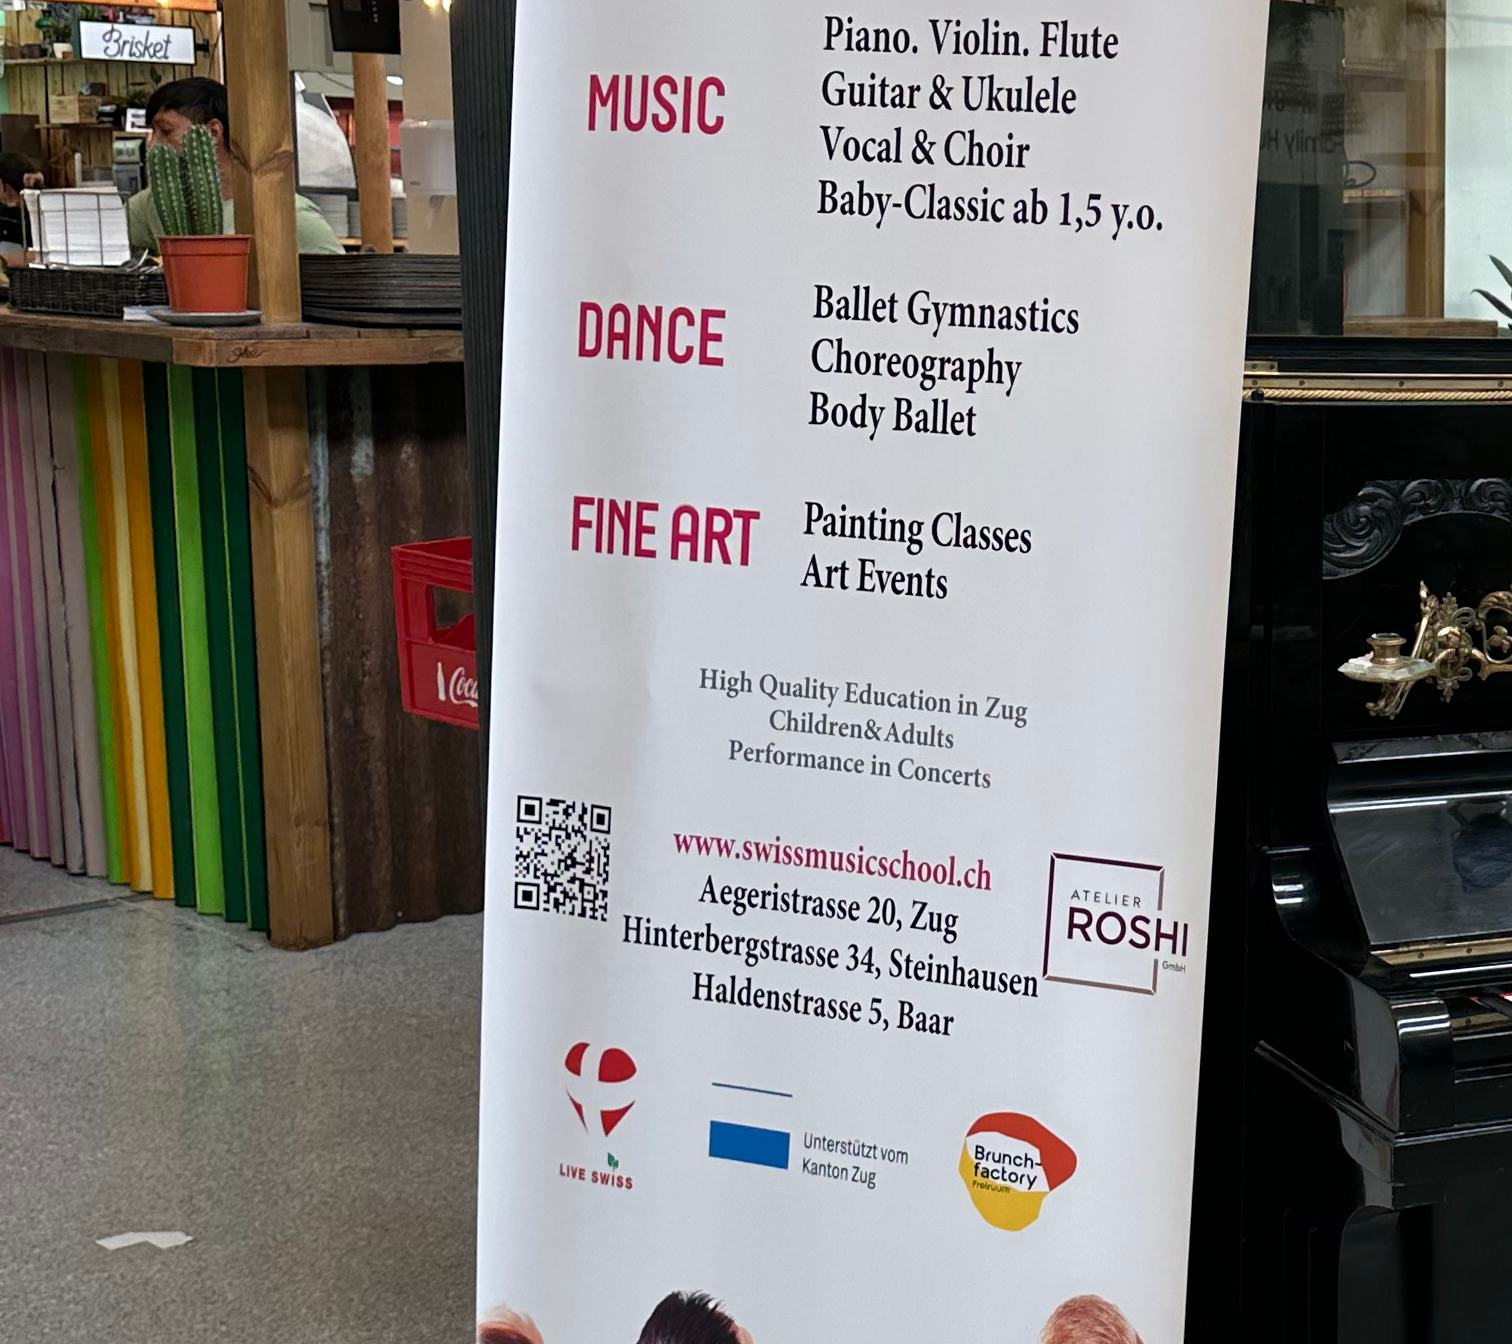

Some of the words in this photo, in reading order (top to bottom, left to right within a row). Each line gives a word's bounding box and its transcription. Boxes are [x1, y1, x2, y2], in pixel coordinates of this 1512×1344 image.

[102, 24, 171, 60] Brisket
[822, 15, 919, 55] Piano.
[927, 17, 1030, 58] Violin.
[1038, 19, 1119, 60] Flute
[587, 73, 726, 136] MUSIC
[821, 70, 922, 110] Guitar
[928, 73, 955, 112] &
[961, 73, 1077, 115] Ukulele
[819, 124, 903, 164] Vocal
[910, 128, 938, 166] &
[943, 128, 1031, 169] Choir
[816, 179, 1006, 230] Baby-Classic
[1012, 186, 1049, 226] ab
[1058, 191, 1102, 234] 1,5
[1110, 203, 1163, 242] y.o.
[577, 300, 727, 368] DANCE
[812, 284, 899, 324] Ballet
[906, 289, 1080, 339] Gymnastics
[810, 337, 1023, 398] Choreography
[807, 390, 887, 442] Body
[891, 396, 978, 437] Ballet
[571, 495, 660, 559] FINE
[669, 503, 761, 567] ART
[802, 500, 926, 557] Painting
[931, 511, 1032, 554] Classes
[799, 553, 850, 591] Art
[855, 557, 948, 600] Events
[698, 667, 753, 699] High
[759, 673, 840, 709] Quality
[843, 681, 952, 714] Education
[956, 693, 979, 717] in
[984, 695, 1028, 729] Zug
[728, 739, 865, 775] Performance
[870, 753, 892, 778] in
[897, 757, 991, 789] Concerts
[672, 833, 992, 892] www.swissmusicschool.ch
[697, 874, 861, 922] Aegeristrasse
[866, 895, 903, 933] 20,
[909, 899, 960, 945] Zug
[1070, 889, 1141, 908] ATELIER
[622, 913, 840, 970] Hinterbergstrasse
[845, 943, 882, 981] 34,
[888, 947, 1039, 998] Steinhausen
[1067, 906, 1188, 957] ROSHI
[691, 971, 863, 1023] Haldenstrasse
[867, 996, 890, 1032] 5,
[896, 999, 955, 1037] Baar
[802, 1157, 849, 1181] Kanton
[851, 1165, 877, 1190] Zug
[803, 1131, 879, 1161] Unterstützt
[880, 1147, 909, 1166] vom
[974, 1144, 1043, 1169] Brunch-
[559, 1162, 586, 1181] LIVE
[590, 1170, 633, 1191] SWISS
[973, 1162, 1037, 1190] factory
